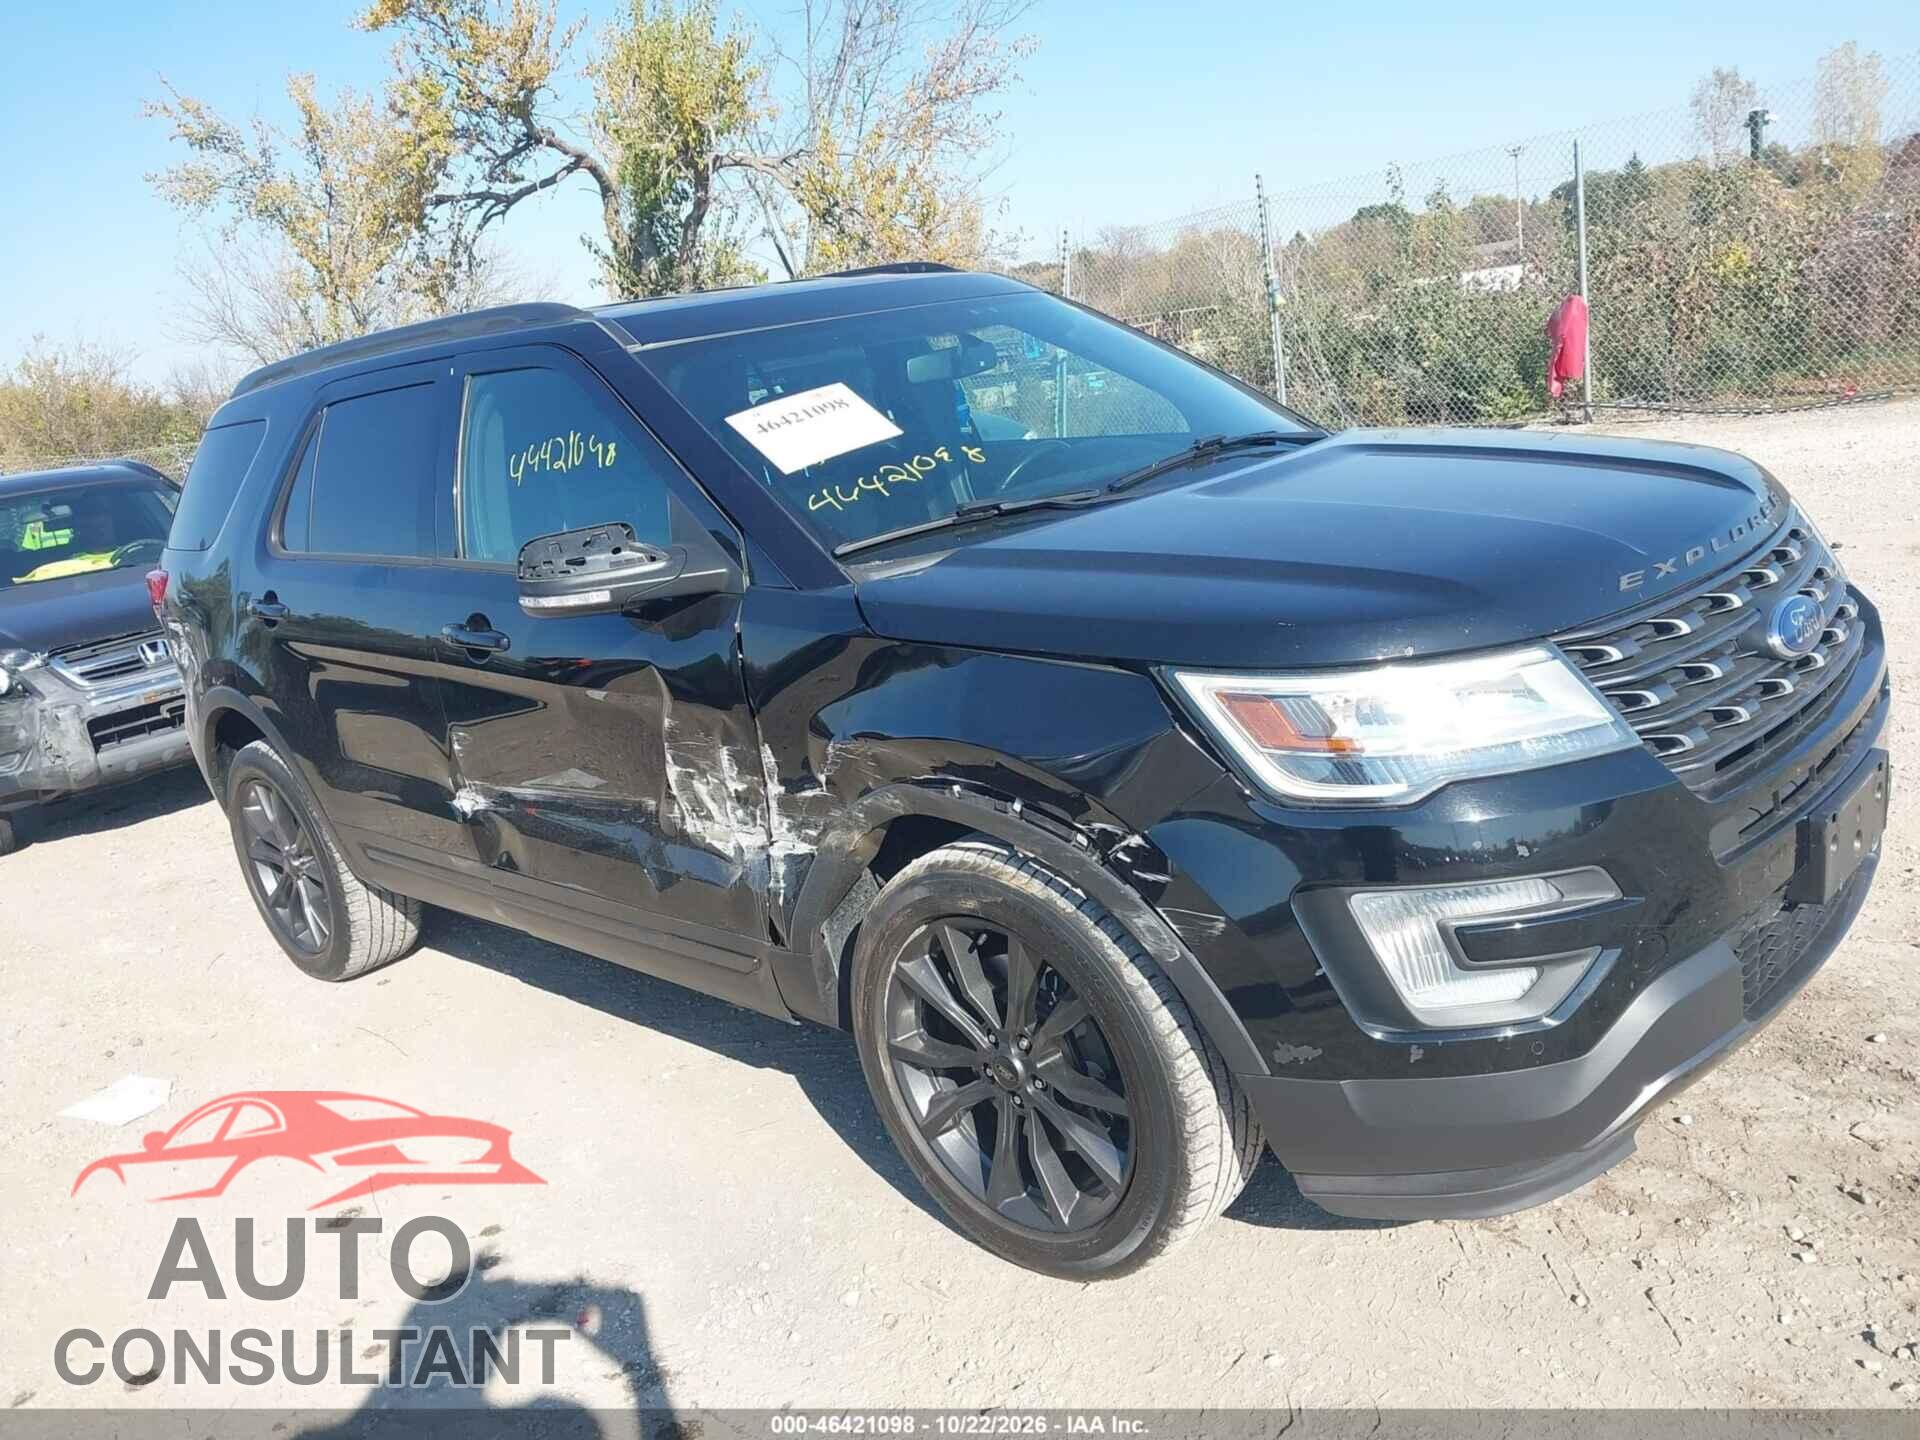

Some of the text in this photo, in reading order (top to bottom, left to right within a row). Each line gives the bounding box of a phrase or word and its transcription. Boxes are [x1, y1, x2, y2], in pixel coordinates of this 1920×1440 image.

[757, 398, 850, 434] 46421098
[1619, 491, 1782, 592] EXPLORER
[1790, 604, 1820, 644] Ford
